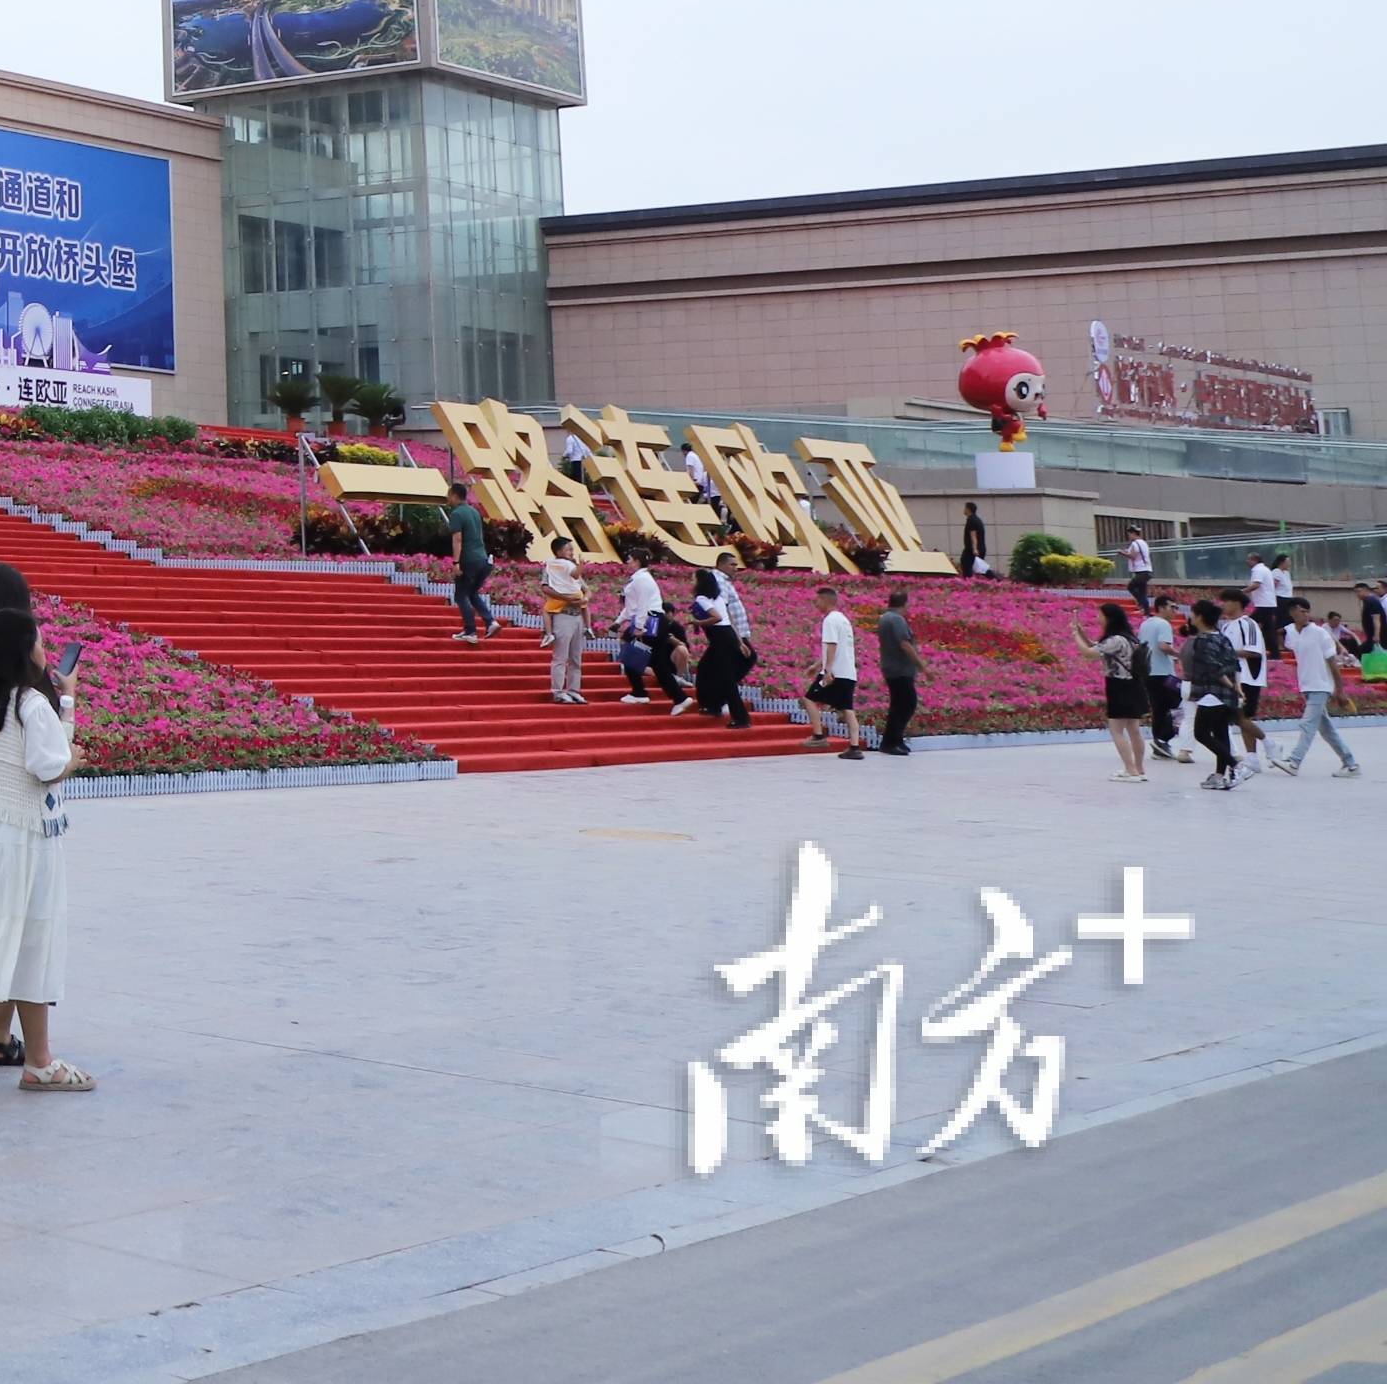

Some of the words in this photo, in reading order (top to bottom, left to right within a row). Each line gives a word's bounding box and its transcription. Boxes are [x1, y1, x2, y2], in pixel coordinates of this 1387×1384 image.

[72, 383, 96, 395] REACH
[319, 397, 958, 575] 一路连欧亚
